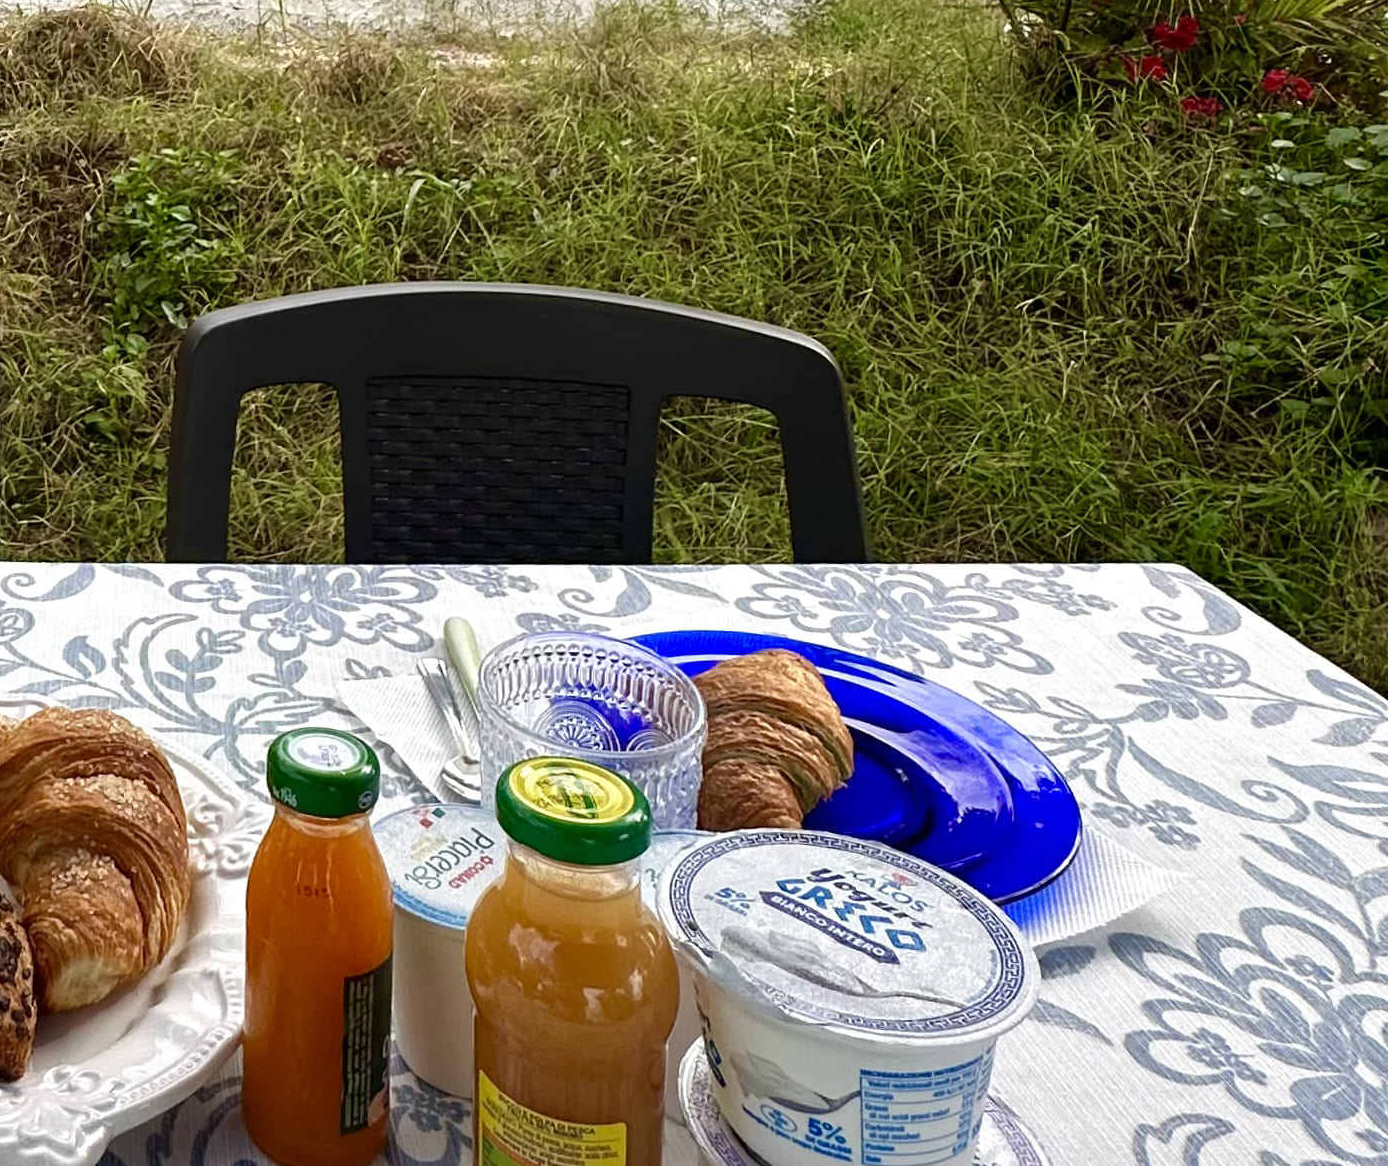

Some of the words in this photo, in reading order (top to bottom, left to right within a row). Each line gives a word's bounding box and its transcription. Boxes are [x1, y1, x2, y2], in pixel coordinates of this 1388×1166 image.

[404, 827, 495, 890] Piacersi
[448, 861, 486, 889] CONAD
[715, 887, 756, 910] 5%
[845, 870, 931, 913] KALOS
[770, 895, 829, 928] BIANCO
[827, 925, 886, 958] INTERO
[776, 878, 927, 952] GRECO
[864, 1091, 894, 1101] Energia
[807, 1117, 847, 1145] 5%
